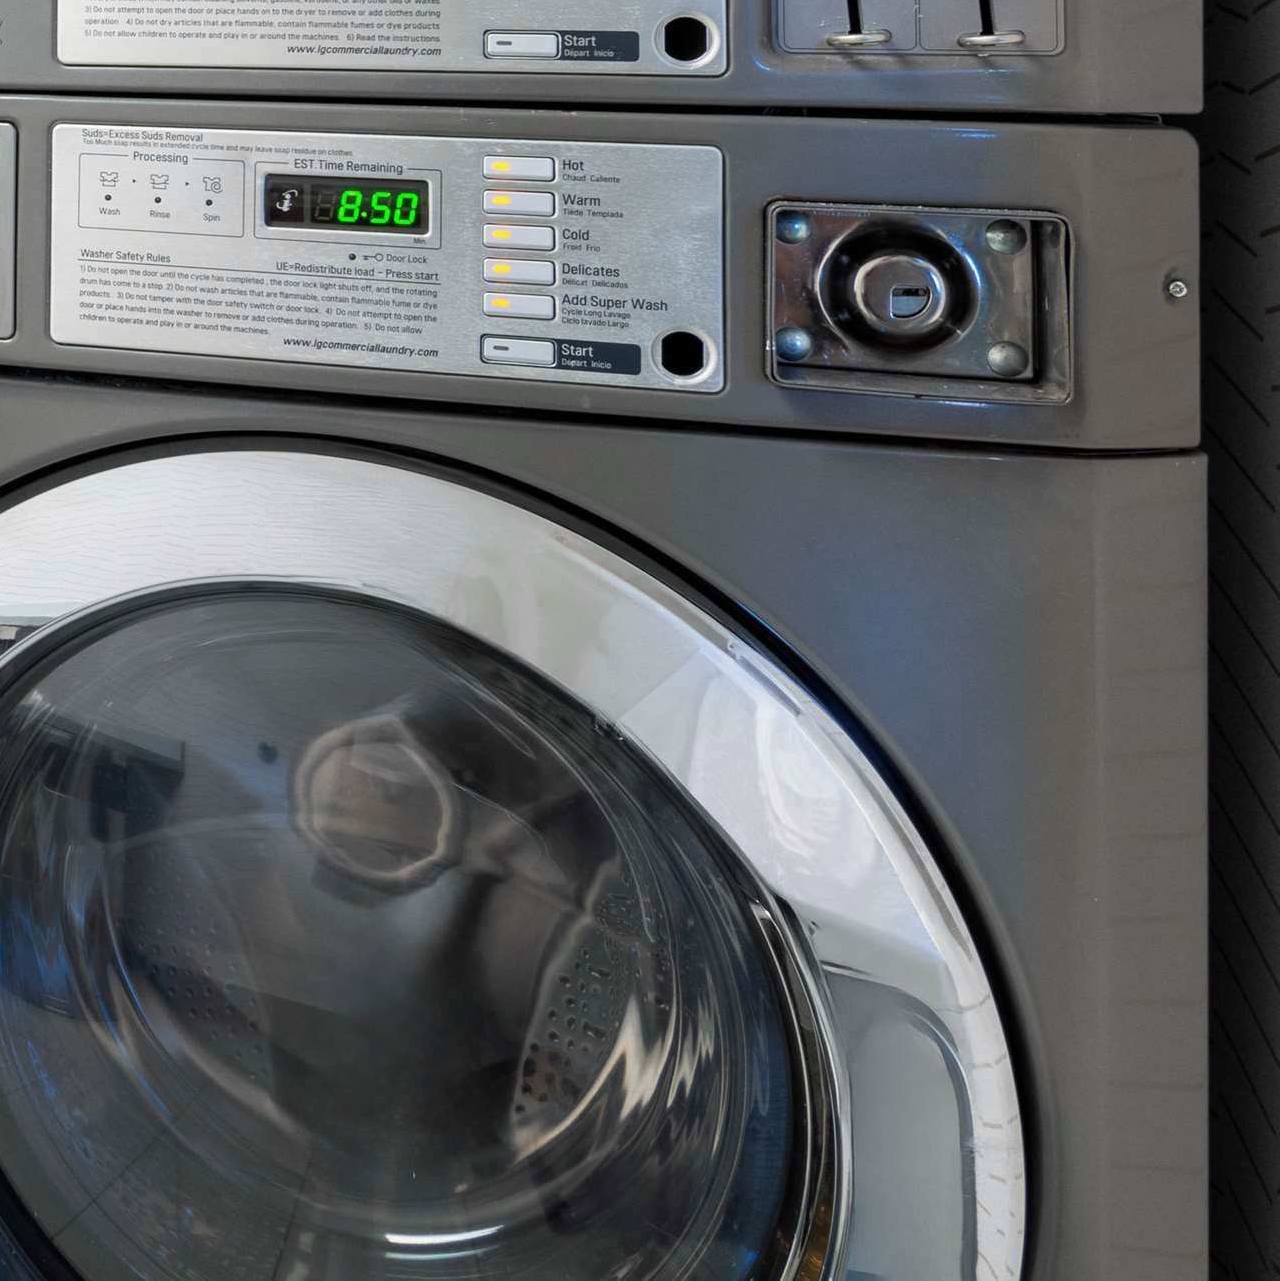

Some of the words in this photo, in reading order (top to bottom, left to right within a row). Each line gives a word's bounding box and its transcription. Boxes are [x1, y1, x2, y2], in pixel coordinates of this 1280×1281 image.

[564, 34, 597, 46] Start
[142, 131, 163, 140] Suds
[165, 132, 203, 142] Removal
[133, 151, 189, 165] Processing
[346, 161, 403, 175] Remaining
[563, 159, 584, 171] Hot
[562, 194, 601, 206] Warm
[99, 207, 121, 216] Wash
[338, 190, 418, 225] 8.50
[149, 210, 170, 218] Rinse
[203, 214, 220, 222] Spin
[562, 228, 589, 240] Cold
[80, 249, 113, 259] Washer
[115, 251, 144, 262] Safety
[146, 253, 171, 263] Rules
[386, 254, 405, 263] Door
[407, 255, 428, 264] Lock
[355, 268, 374, 277] load
[385, 269, 412, 279] Press
[414, 272, 439, 281] start
[562, 263, 620, 277] Delicates
[562, 294, 587, 306] Add
[590, 295, 627, 310] Super
[631, 298, 668, 311] Wash
[561, 344, 593, 357] Start
